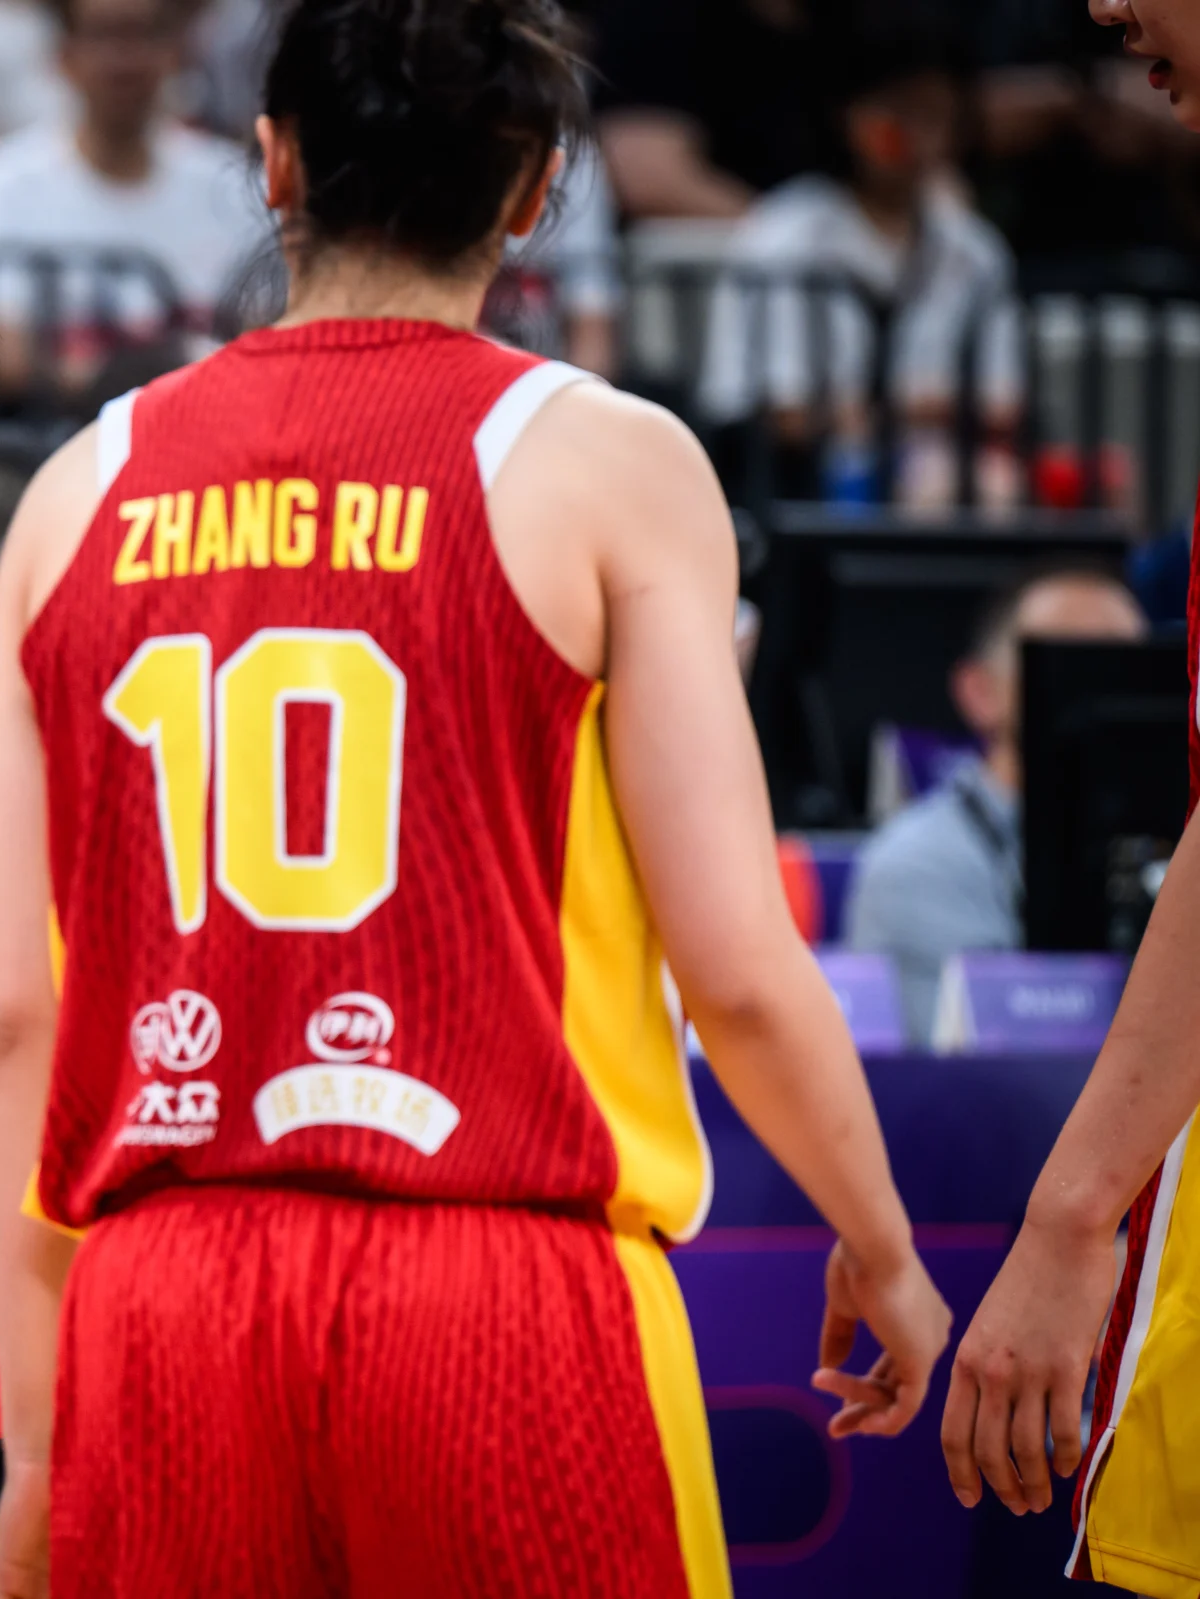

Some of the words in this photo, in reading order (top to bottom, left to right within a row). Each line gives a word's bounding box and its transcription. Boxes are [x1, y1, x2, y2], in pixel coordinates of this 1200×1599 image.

[113, 478, 319, 586] ZHANG
[330, 481, 429, 573] RU
[102, 627, 408, 935] 10
